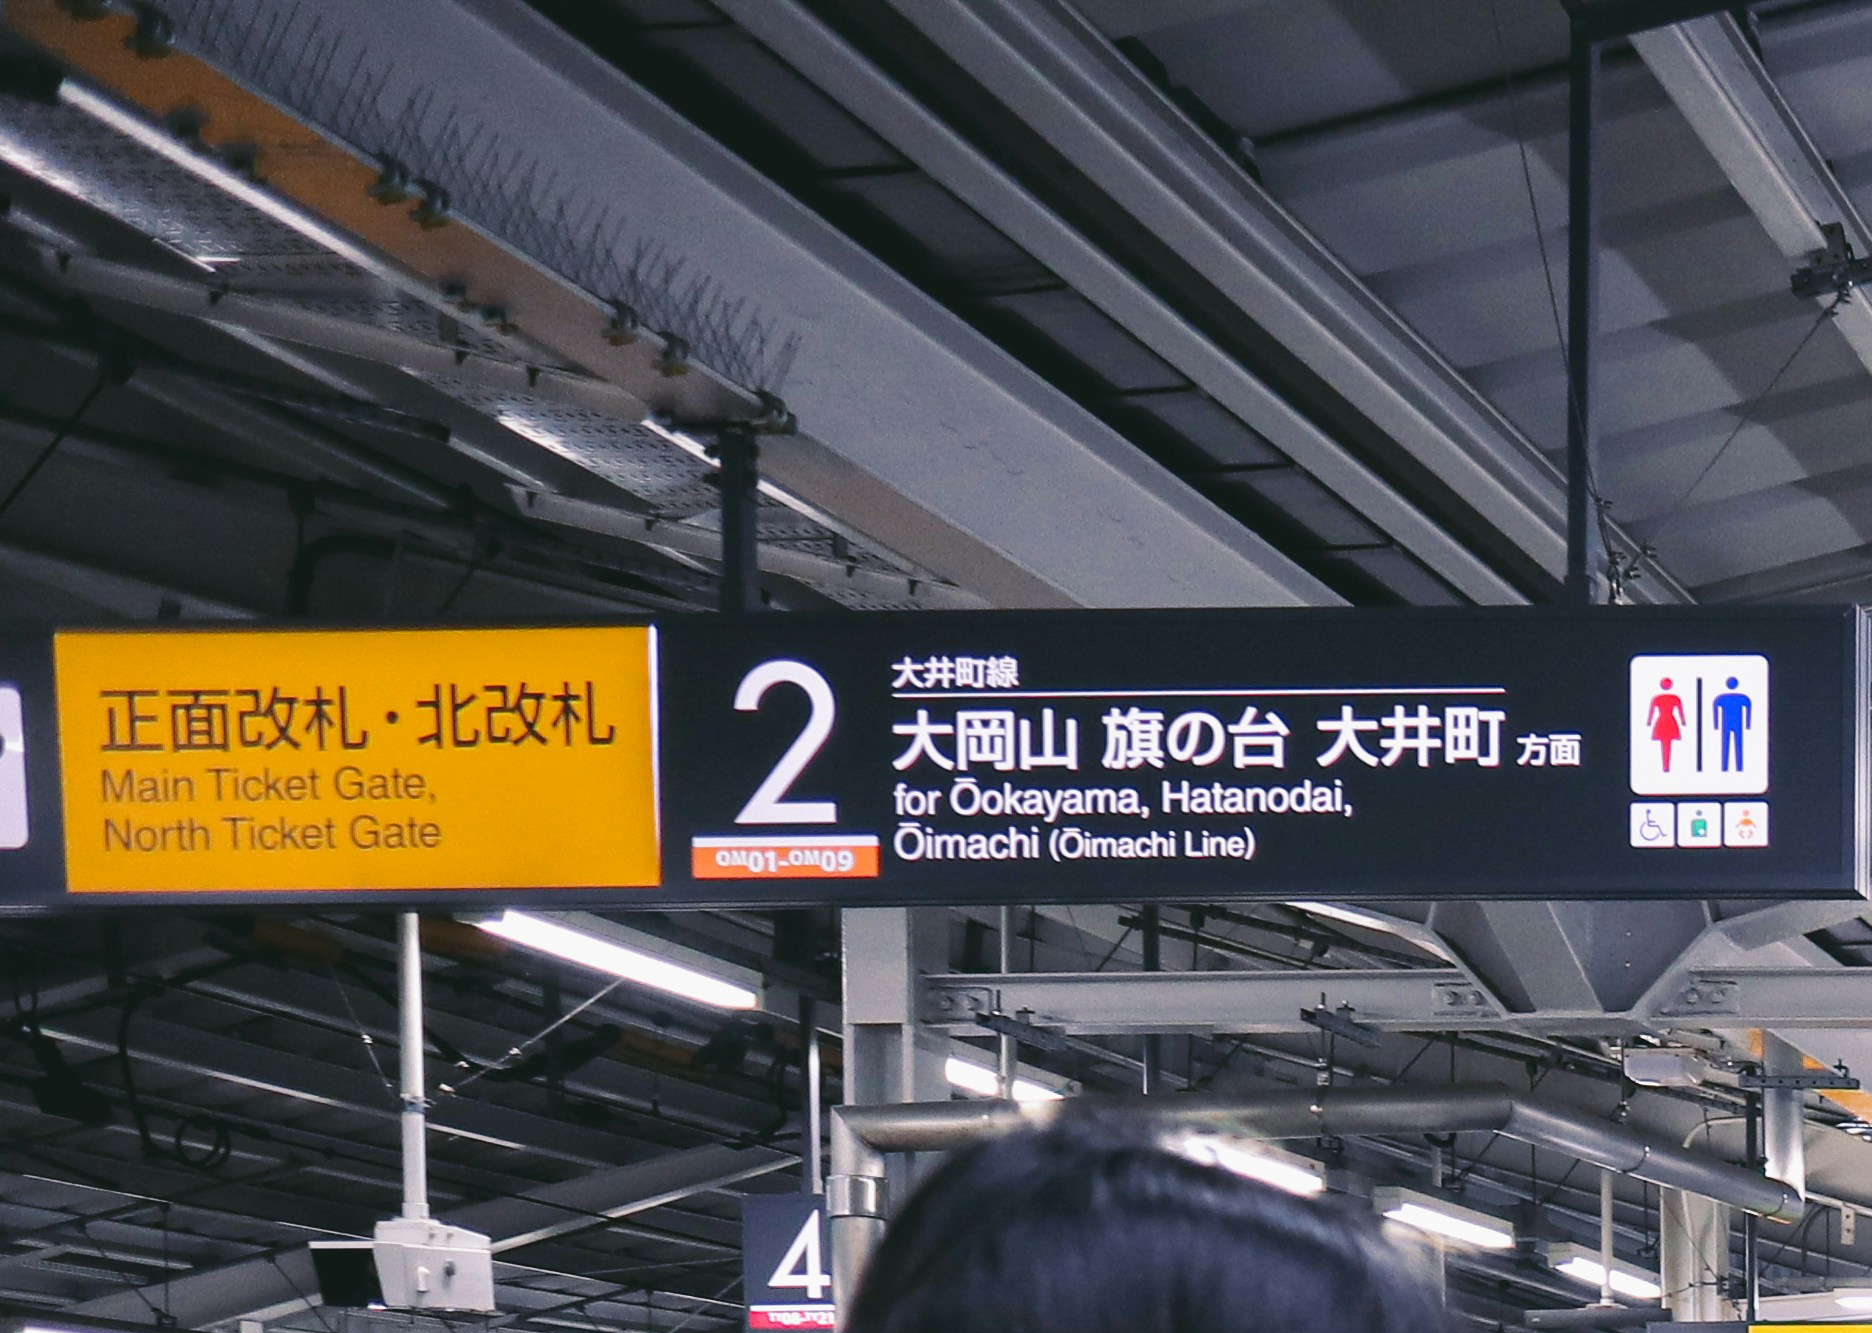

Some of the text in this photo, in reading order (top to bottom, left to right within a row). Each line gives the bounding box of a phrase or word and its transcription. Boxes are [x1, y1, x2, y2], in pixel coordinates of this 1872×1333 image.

[892, 656, 1019, 689] 大井町線
[101, 681, 616, 754] 正面改札・北改札
[892, 706, 1581, 771] 大岡山 旗の台 大井町 方面
[733, 660, 837, 824] 2
[102, 767, 436, 806] Main Ticket Gate,
[894, 777, 1353, 821] for Ōokayama, Hatanodai,
[104, 816, 442, 851] North Ticket Gate
[894, 822, 1256, 862] Ōimachi (Ōimachi Line)
[767, 1209, 831, 1299] 4
